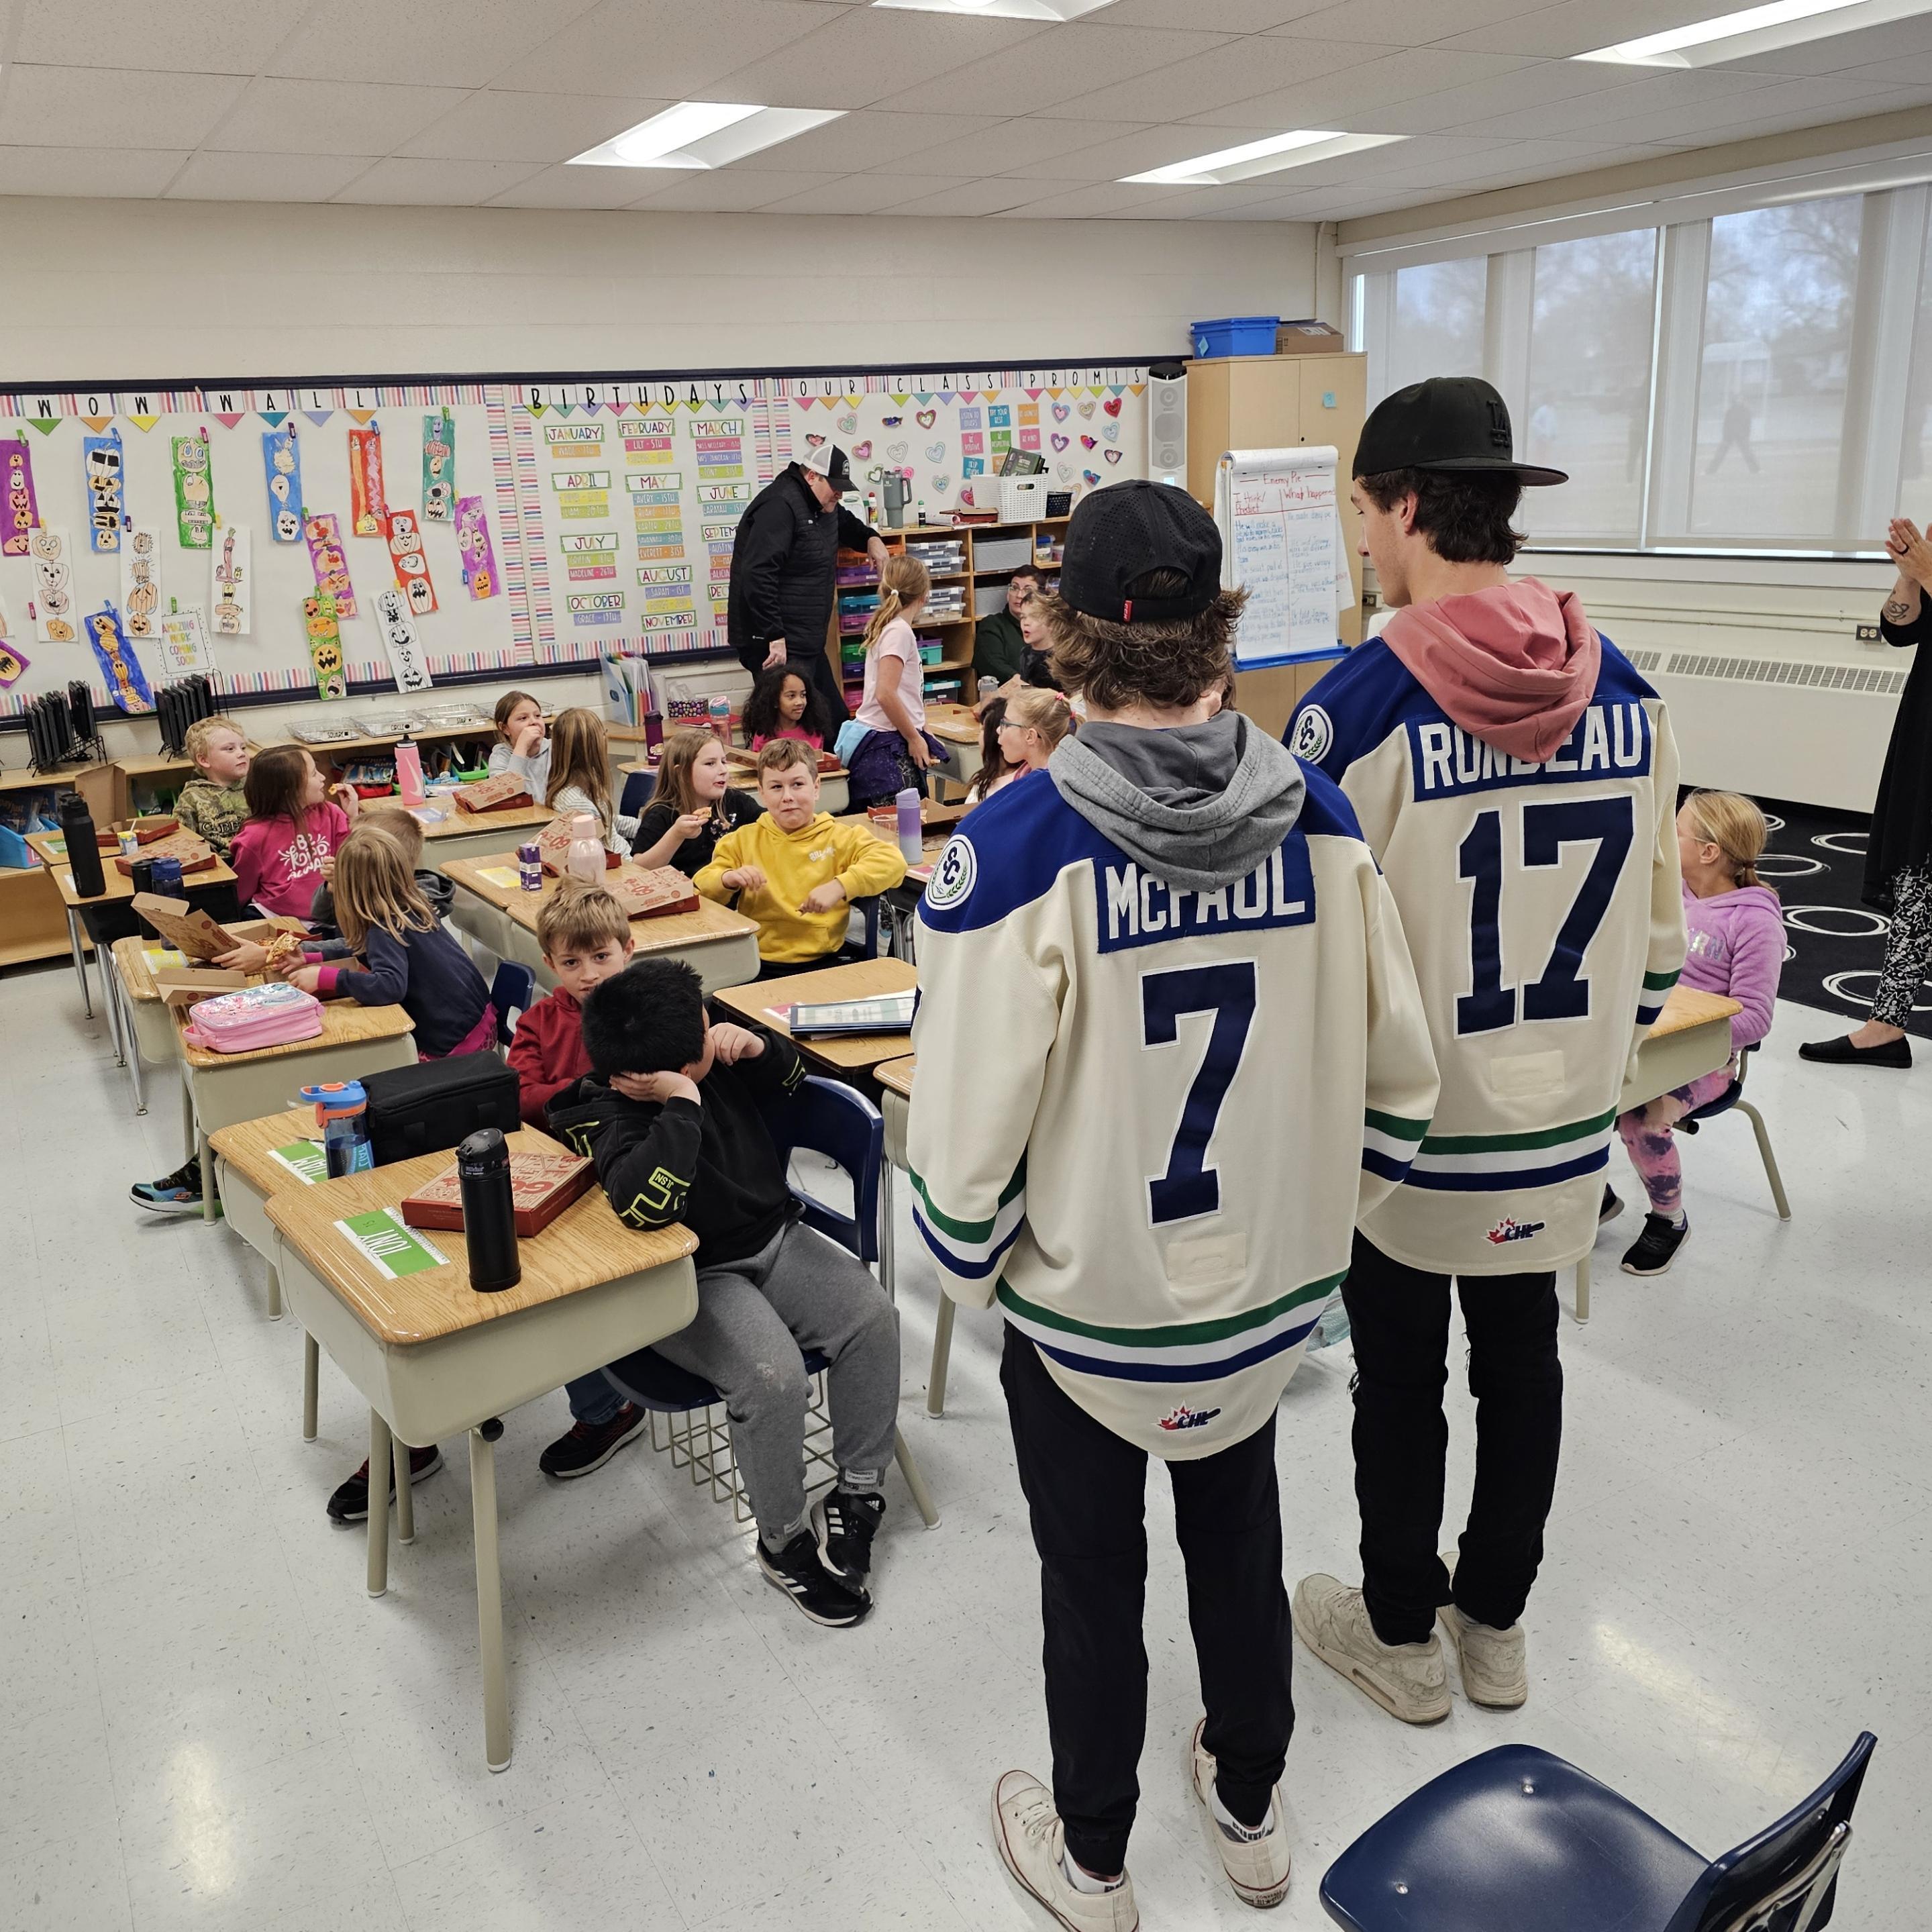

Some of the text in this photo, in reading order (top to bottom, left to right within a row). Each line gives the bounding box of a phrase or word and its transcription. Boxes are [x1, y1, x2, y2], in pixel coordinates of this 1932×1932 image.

[800, 368, 1141, 396] OUR CLASS PROMIS
[219, 390, 364, 412] WALL
[531, 383, 748, 409] BIRTHDAYS
[548, 427, 601, 441] JANUARY
[621, 421, 672, 435] FEBRUARY
[697, 421, 737, 436] MARCH
[567, 472, 597, 488] APRIL
[640, 474, 668, 489] MAY
[1263, 470, 1302, 487] Enemy Pie
[709, 486, 739, 500] JUNE
[705, 525, 738, 539] SEPTEM
[574, 536, 605, 550] JULY
[642, 567, 687, 582] AUGUST
[570, 595, 621, 610] OCTOBER
[162, 619, 195, 634] AMAZING
[645, 613, 693, 628] NOVEMBER
[169, 643, 197, 656] COMING
[1418, 703, 1643, 790] RONEAU
[1454, 792, 1635, 1039] 17
[1139, 956, 1260, 1229] 7
[356, 1228, 413, 1260] TONY
[1256, 1889, 1283, 1900] CONVERSE
